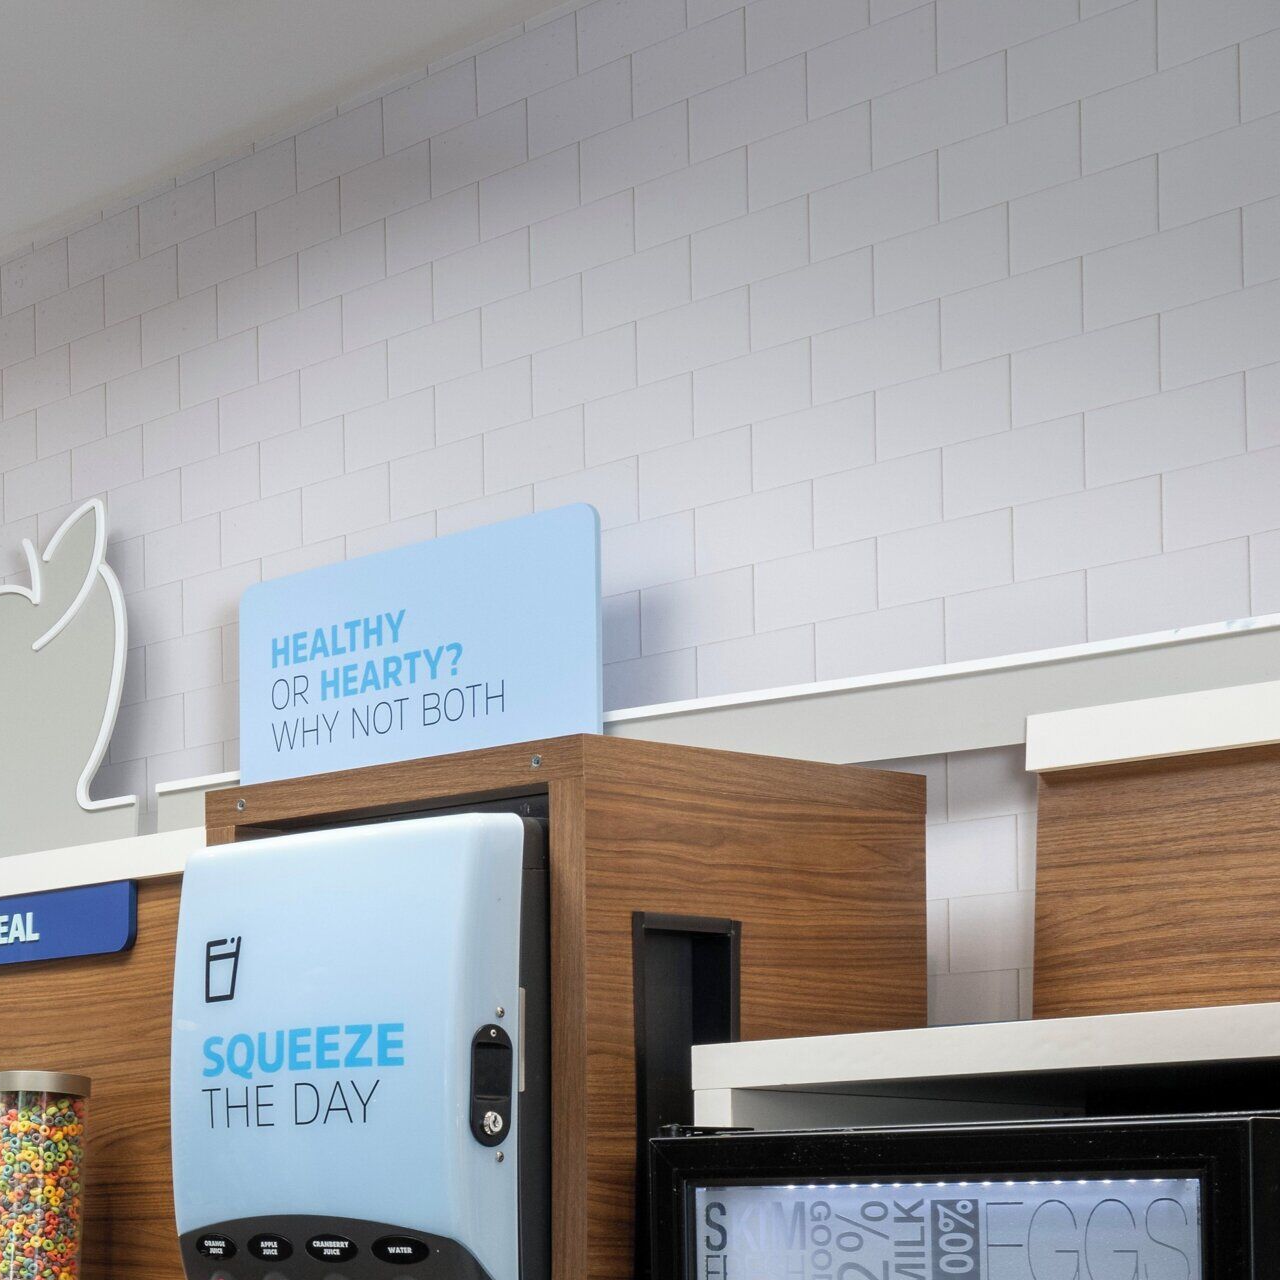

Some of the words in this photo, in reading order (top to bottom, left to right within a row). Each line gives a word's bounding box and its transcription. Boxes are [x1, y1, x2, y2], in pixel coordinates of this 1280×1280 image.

[270, 609, 407, 669] HEALTHY
[270, 674, 310, 711] OR
[319, 641, 464, 702] HEARTY?
[270, 709, 341, 753] WHY
[350, 696, 410, 740] NOT
[422, 679, 507, 728] BOTH
[202, 1022, 405, 1080] SQUEEZE
[201, 1084, 276, 1130] THE
[294, 1079, 381, 1127] DAY
[204, 1240, 226, 1248] ORANGE
[312, 1240, 349, 1249] CRANBERRY
[209, 1247, 224, 1255] JUICE
[262, 1248, 279, 1256] JUICE
[323, 1248, 341, 1256] JUICE
[387, 1246, 414, 1255] WATER
